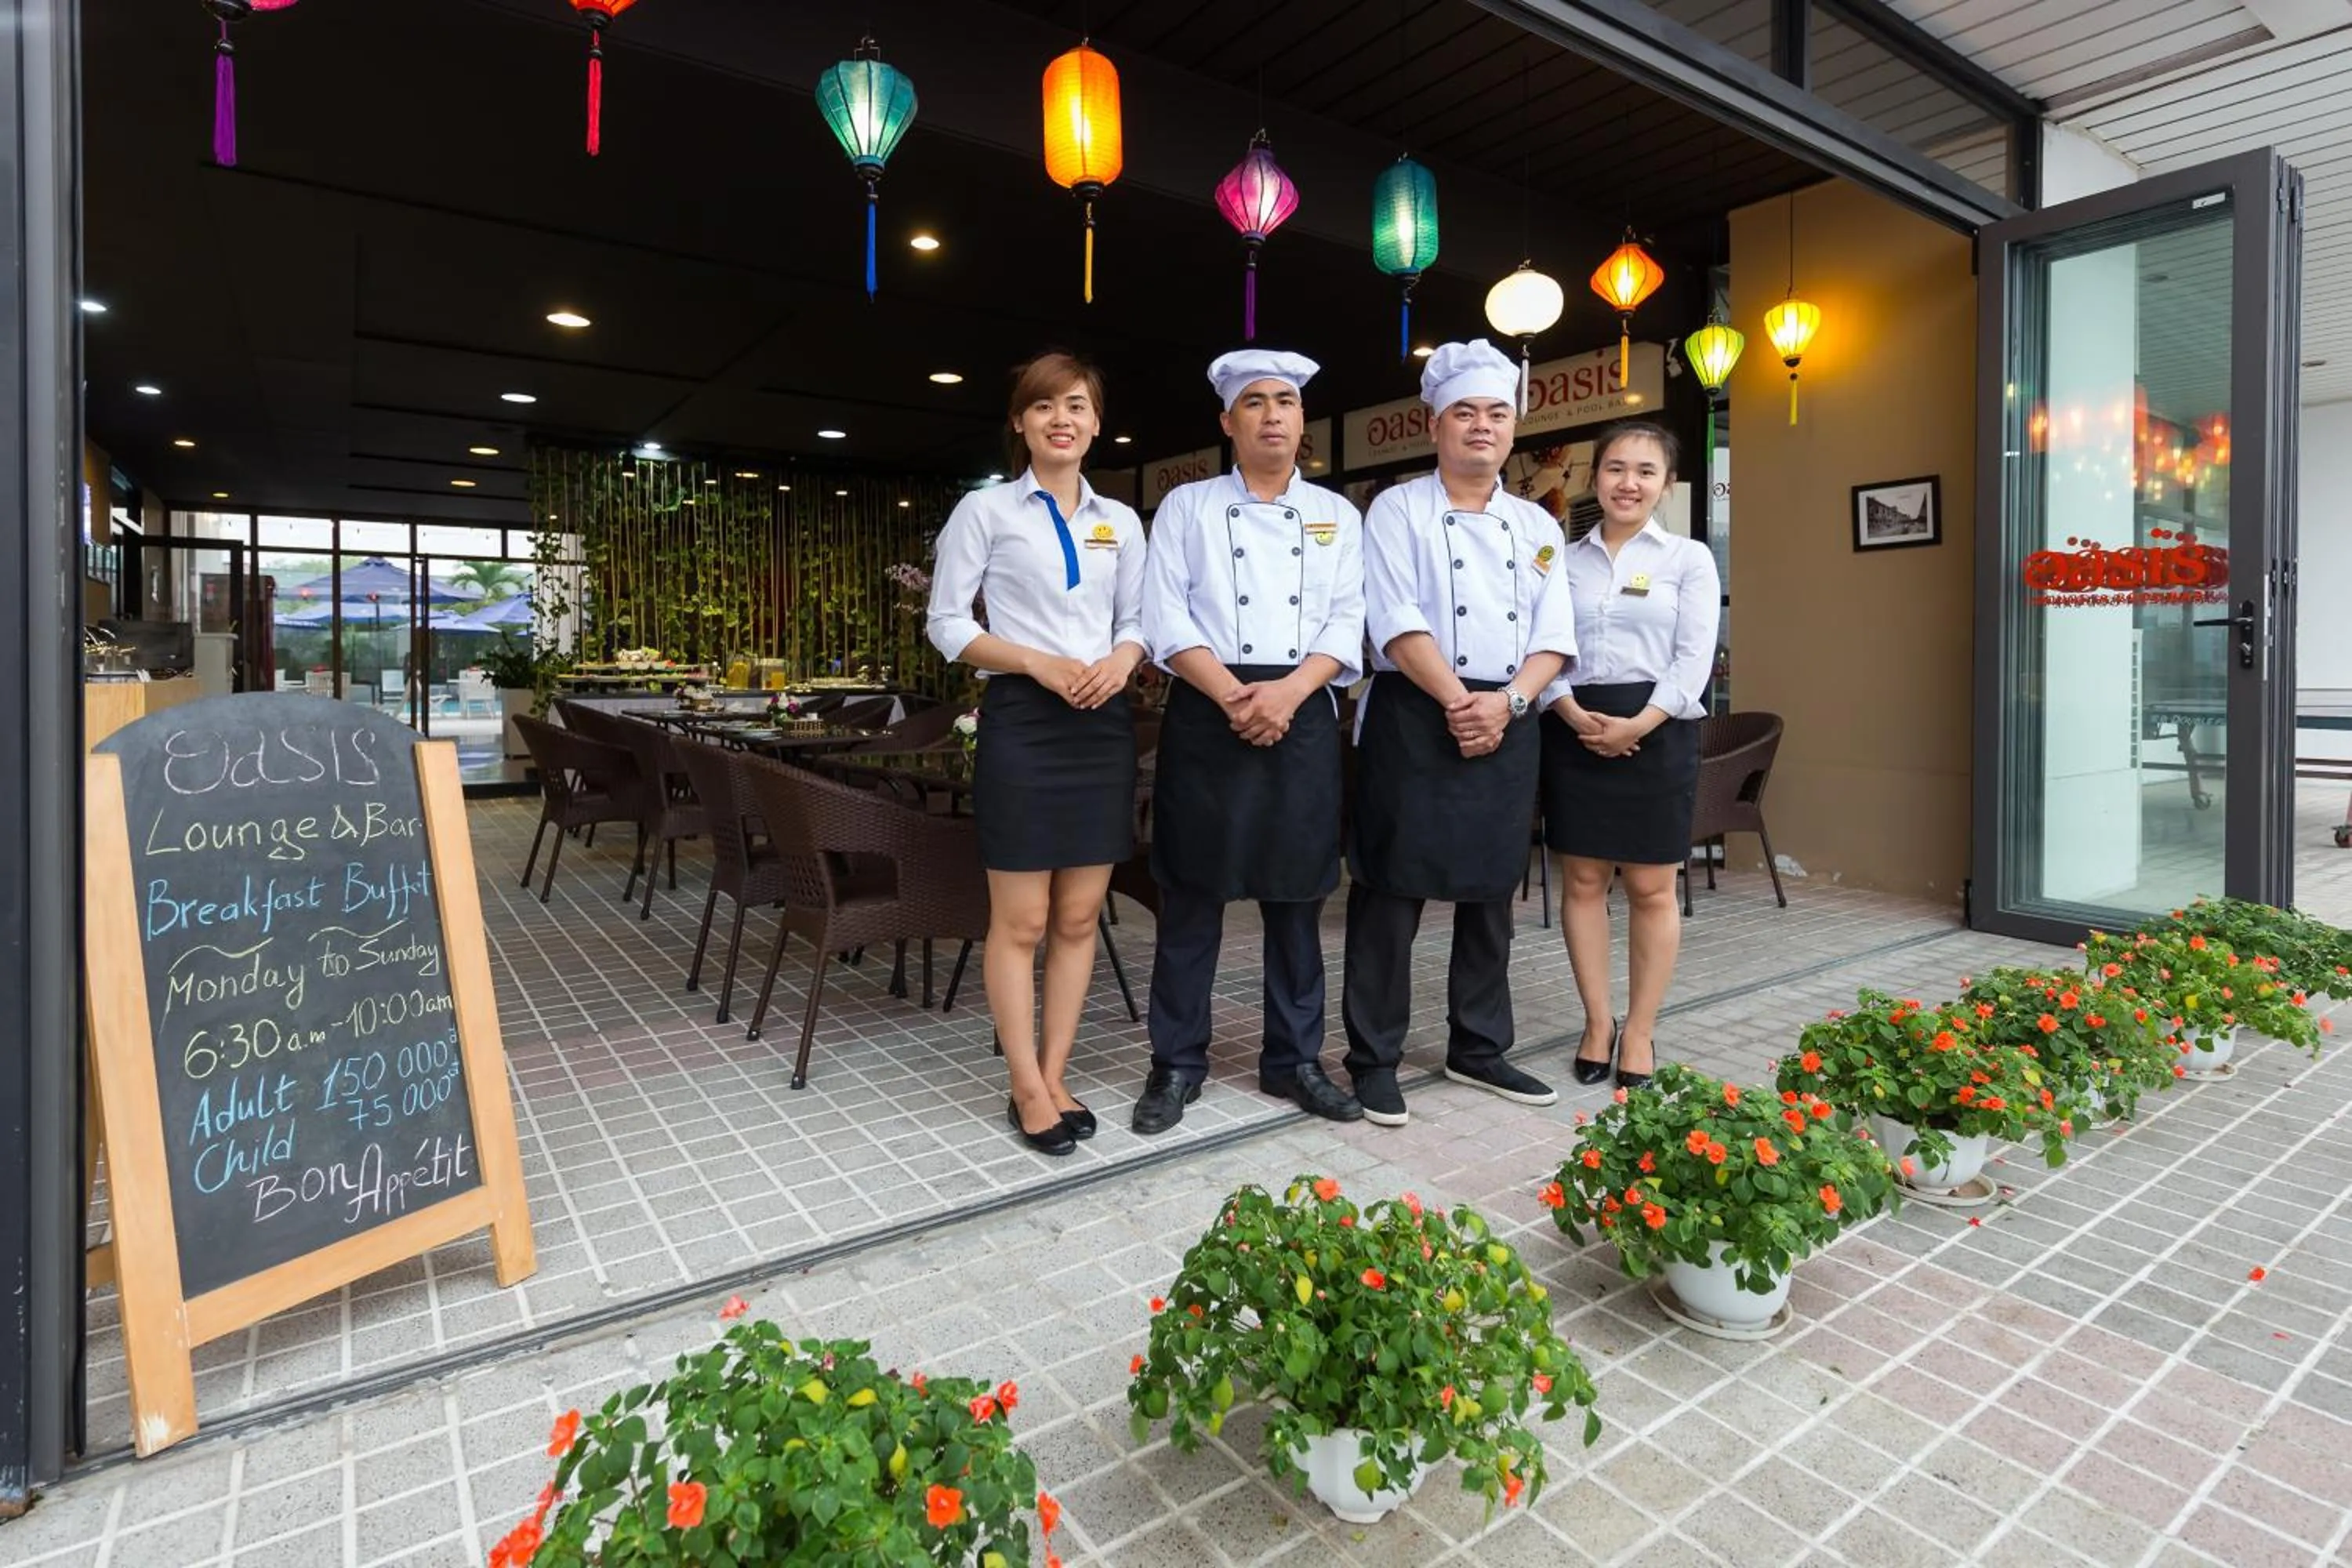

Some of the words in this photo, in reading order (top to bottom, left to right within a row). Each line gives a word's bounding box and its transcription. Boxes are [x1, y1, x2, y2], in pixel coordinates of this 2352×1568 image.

[1367, 407, 1429, 446] oasi
[1522, 412, 1559, 426] OUNGE
[145, 807, 318, 860] Lounge
[360, 801, 422, 848] Bar
[146, 874, 326, 941] Breakfast
[159, 953, 306, 1033] Monday
[317, 940, 350, 978] to
[355, 934, 441, 977] Sunday
[189, 1073, 299, 1146] Adult
[194, 1117, 296, 1194] Child
[245, 1161, 360, 1223] Bon
